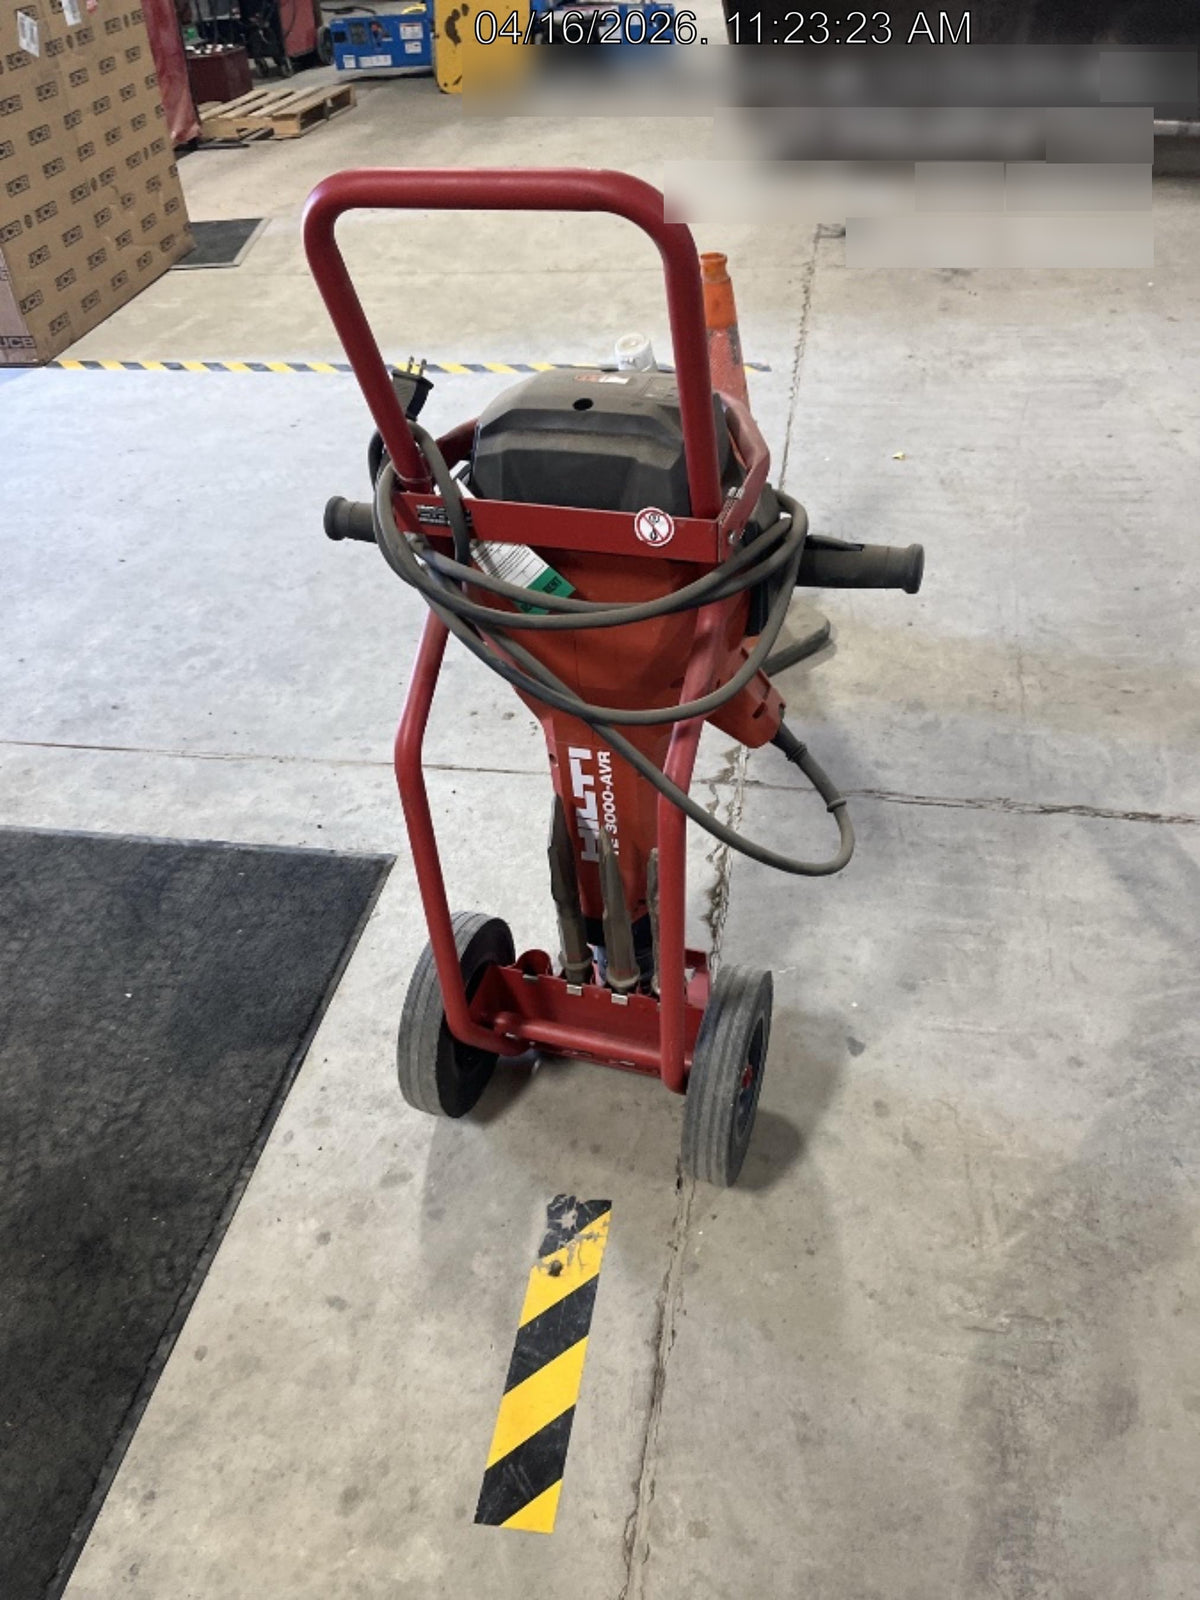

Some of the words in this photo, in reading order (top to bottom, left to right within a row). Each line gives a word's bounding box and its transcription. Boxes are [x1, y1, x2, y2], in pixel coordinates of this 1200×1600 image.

[0, 335, 37, 349] JCB
[568, 746, 601, 863] HILTI
[597, 750, 619, 835] 3000-AVR
